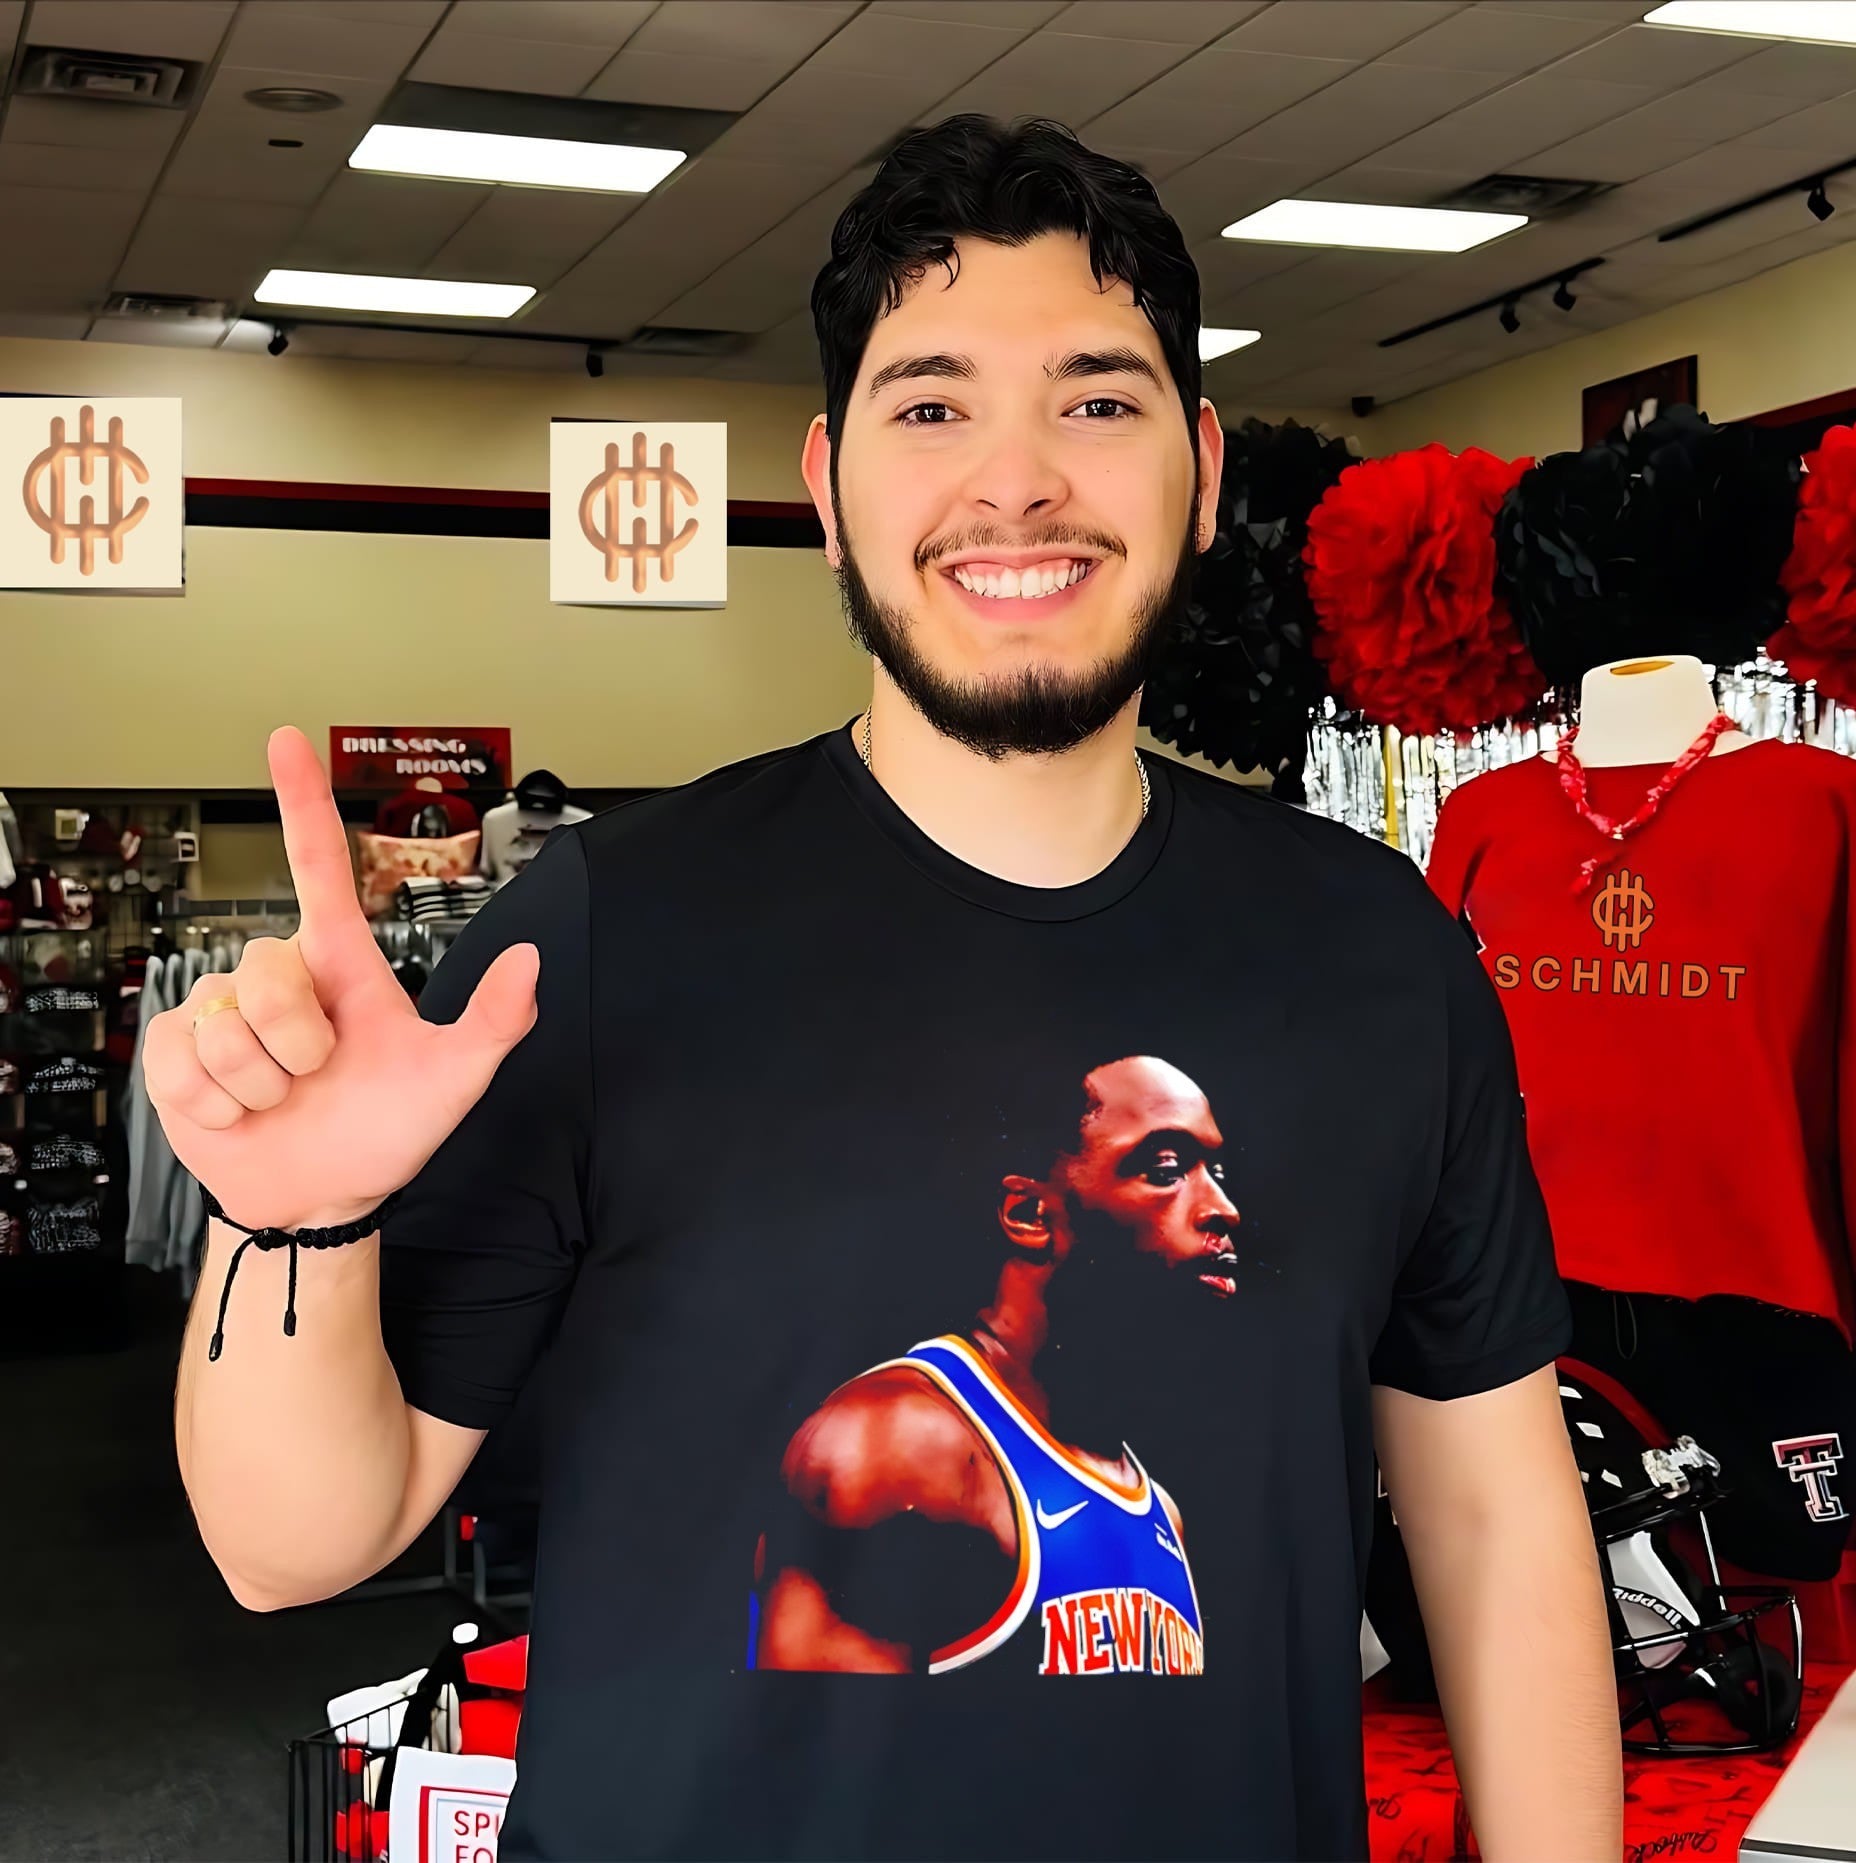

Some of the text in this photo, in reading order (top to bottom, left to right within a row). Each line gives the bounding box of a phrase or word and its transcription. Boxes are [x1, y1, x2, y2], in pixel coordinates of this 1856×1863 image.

[342, 737, 467, 754] DRESSING
[396, 758, 487, 775] ROOMS
[1494, 953, 1746, 1000] SCHMIDT
[1038, 1587, 1148, 1675] NEW
